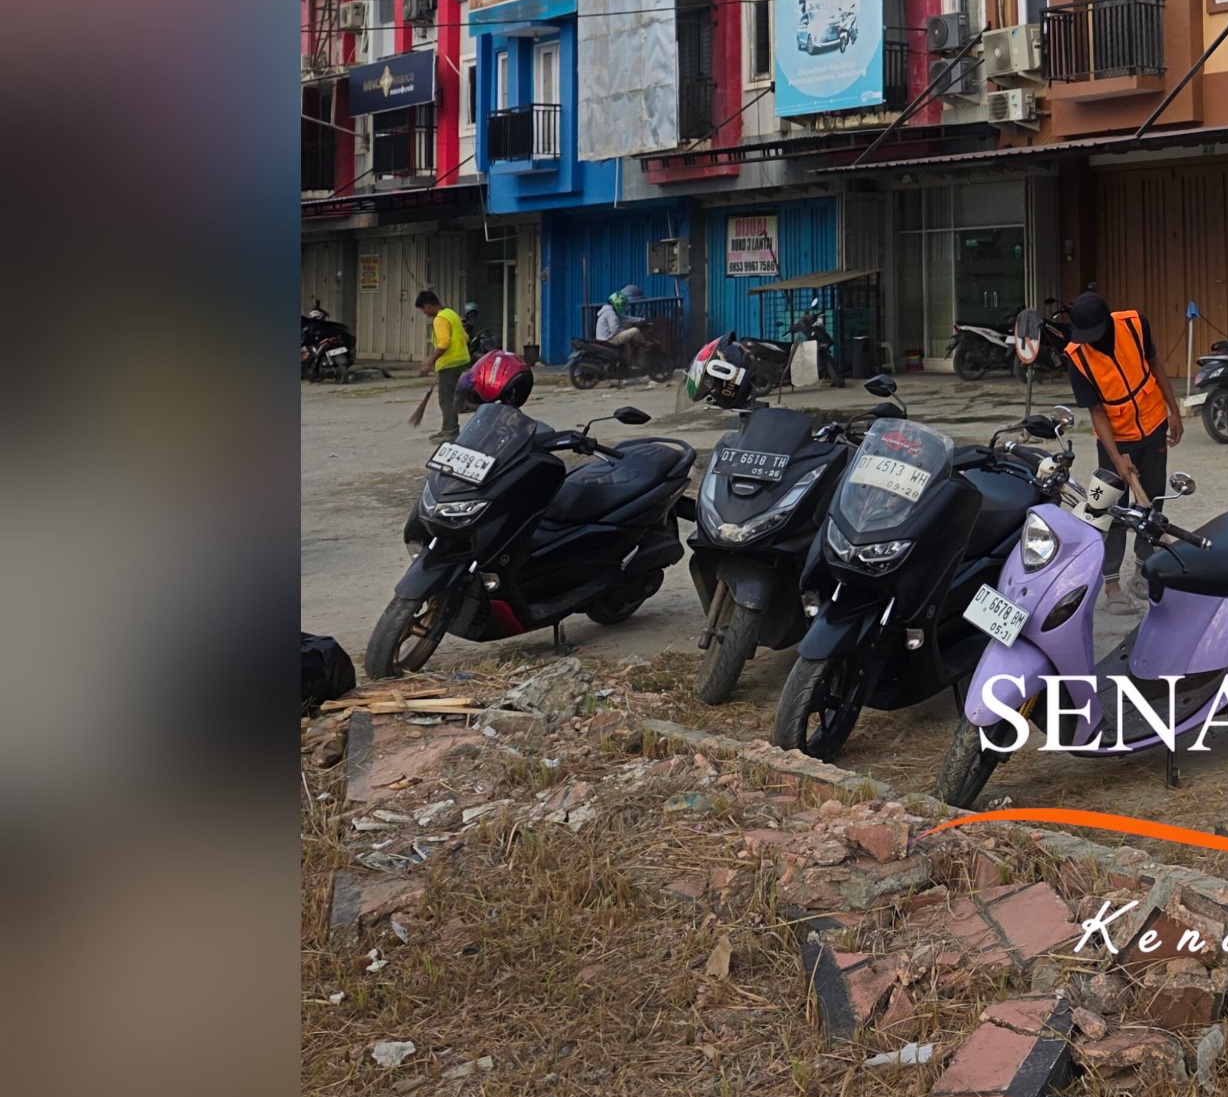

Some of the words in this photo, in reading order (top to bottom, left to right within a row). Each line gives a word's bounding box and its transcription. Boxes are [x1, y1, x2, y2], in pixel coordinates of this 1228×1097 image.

[438, 447, 453, 458] DT
[721, 451, 736, 462] DT
[740, 453, 767, 466] 6618
[772, 456, 787, 468] TH
[859, 457, 873, 470] DT
[876, 460, 905, 476] 4513
[910, 470, 928, 486] WH
[975, 587, 990, 604] DT
[989, 597, 1013, 620] 6678
[1010, 610, 1026, 629] BM
